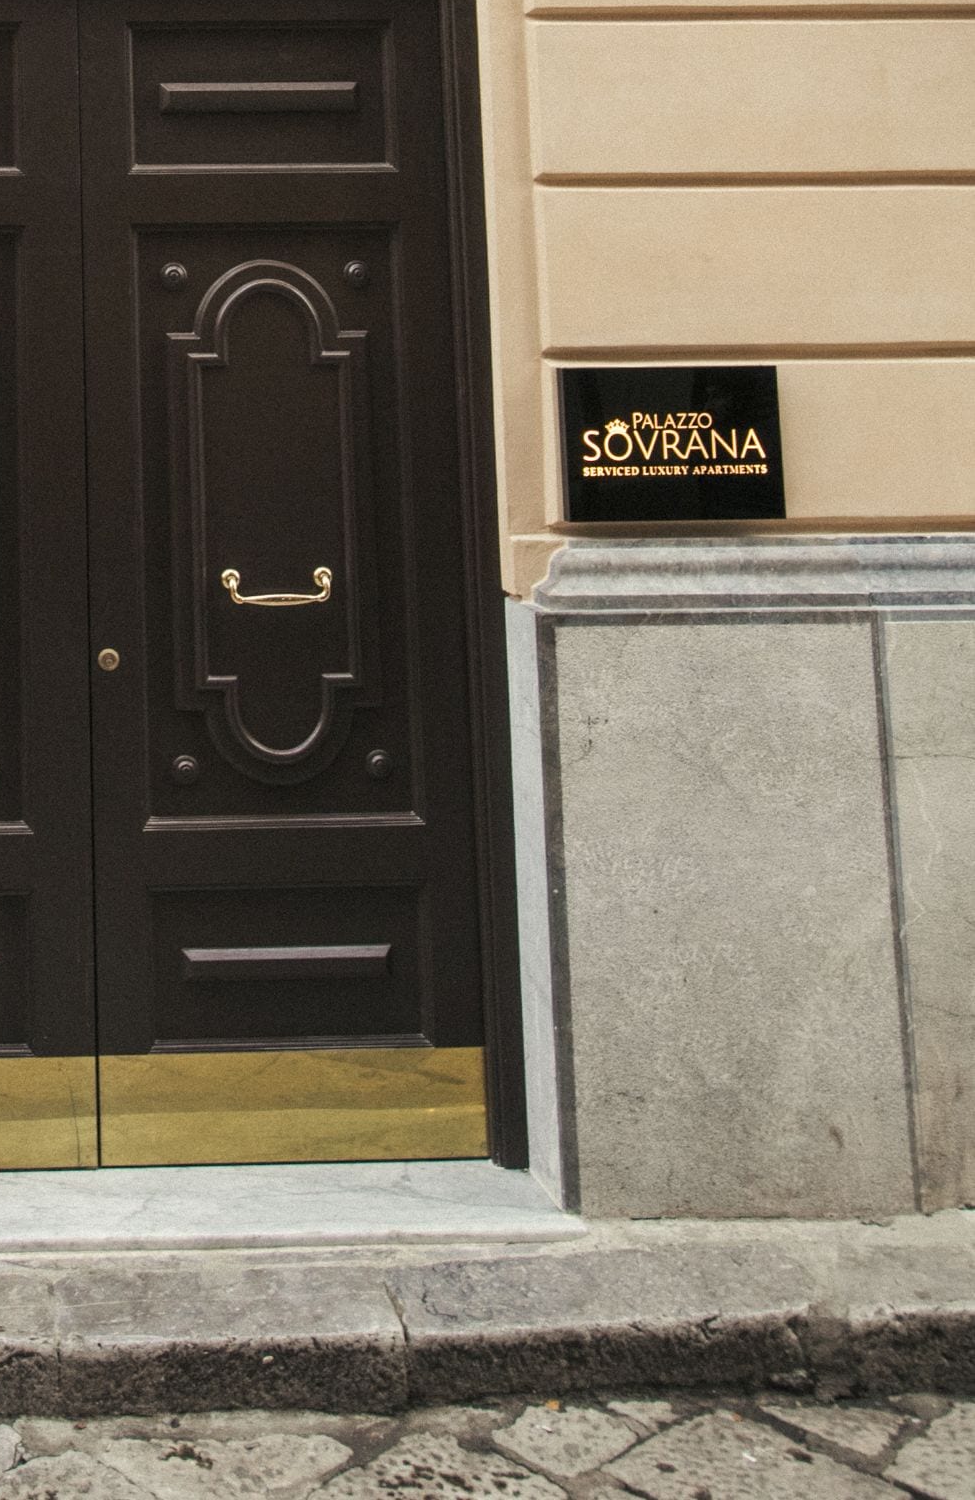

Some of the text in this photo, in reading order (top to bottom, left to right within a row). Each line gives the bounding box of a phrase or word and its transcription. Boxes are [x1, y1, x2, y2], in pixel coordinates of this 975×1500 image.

[632, 411, 713, 430] PALAZZO
[582, 428, 767, 462] SOVRANA
[582, 464, 768, 477] SERVICED LUXURY APARTMENTS
